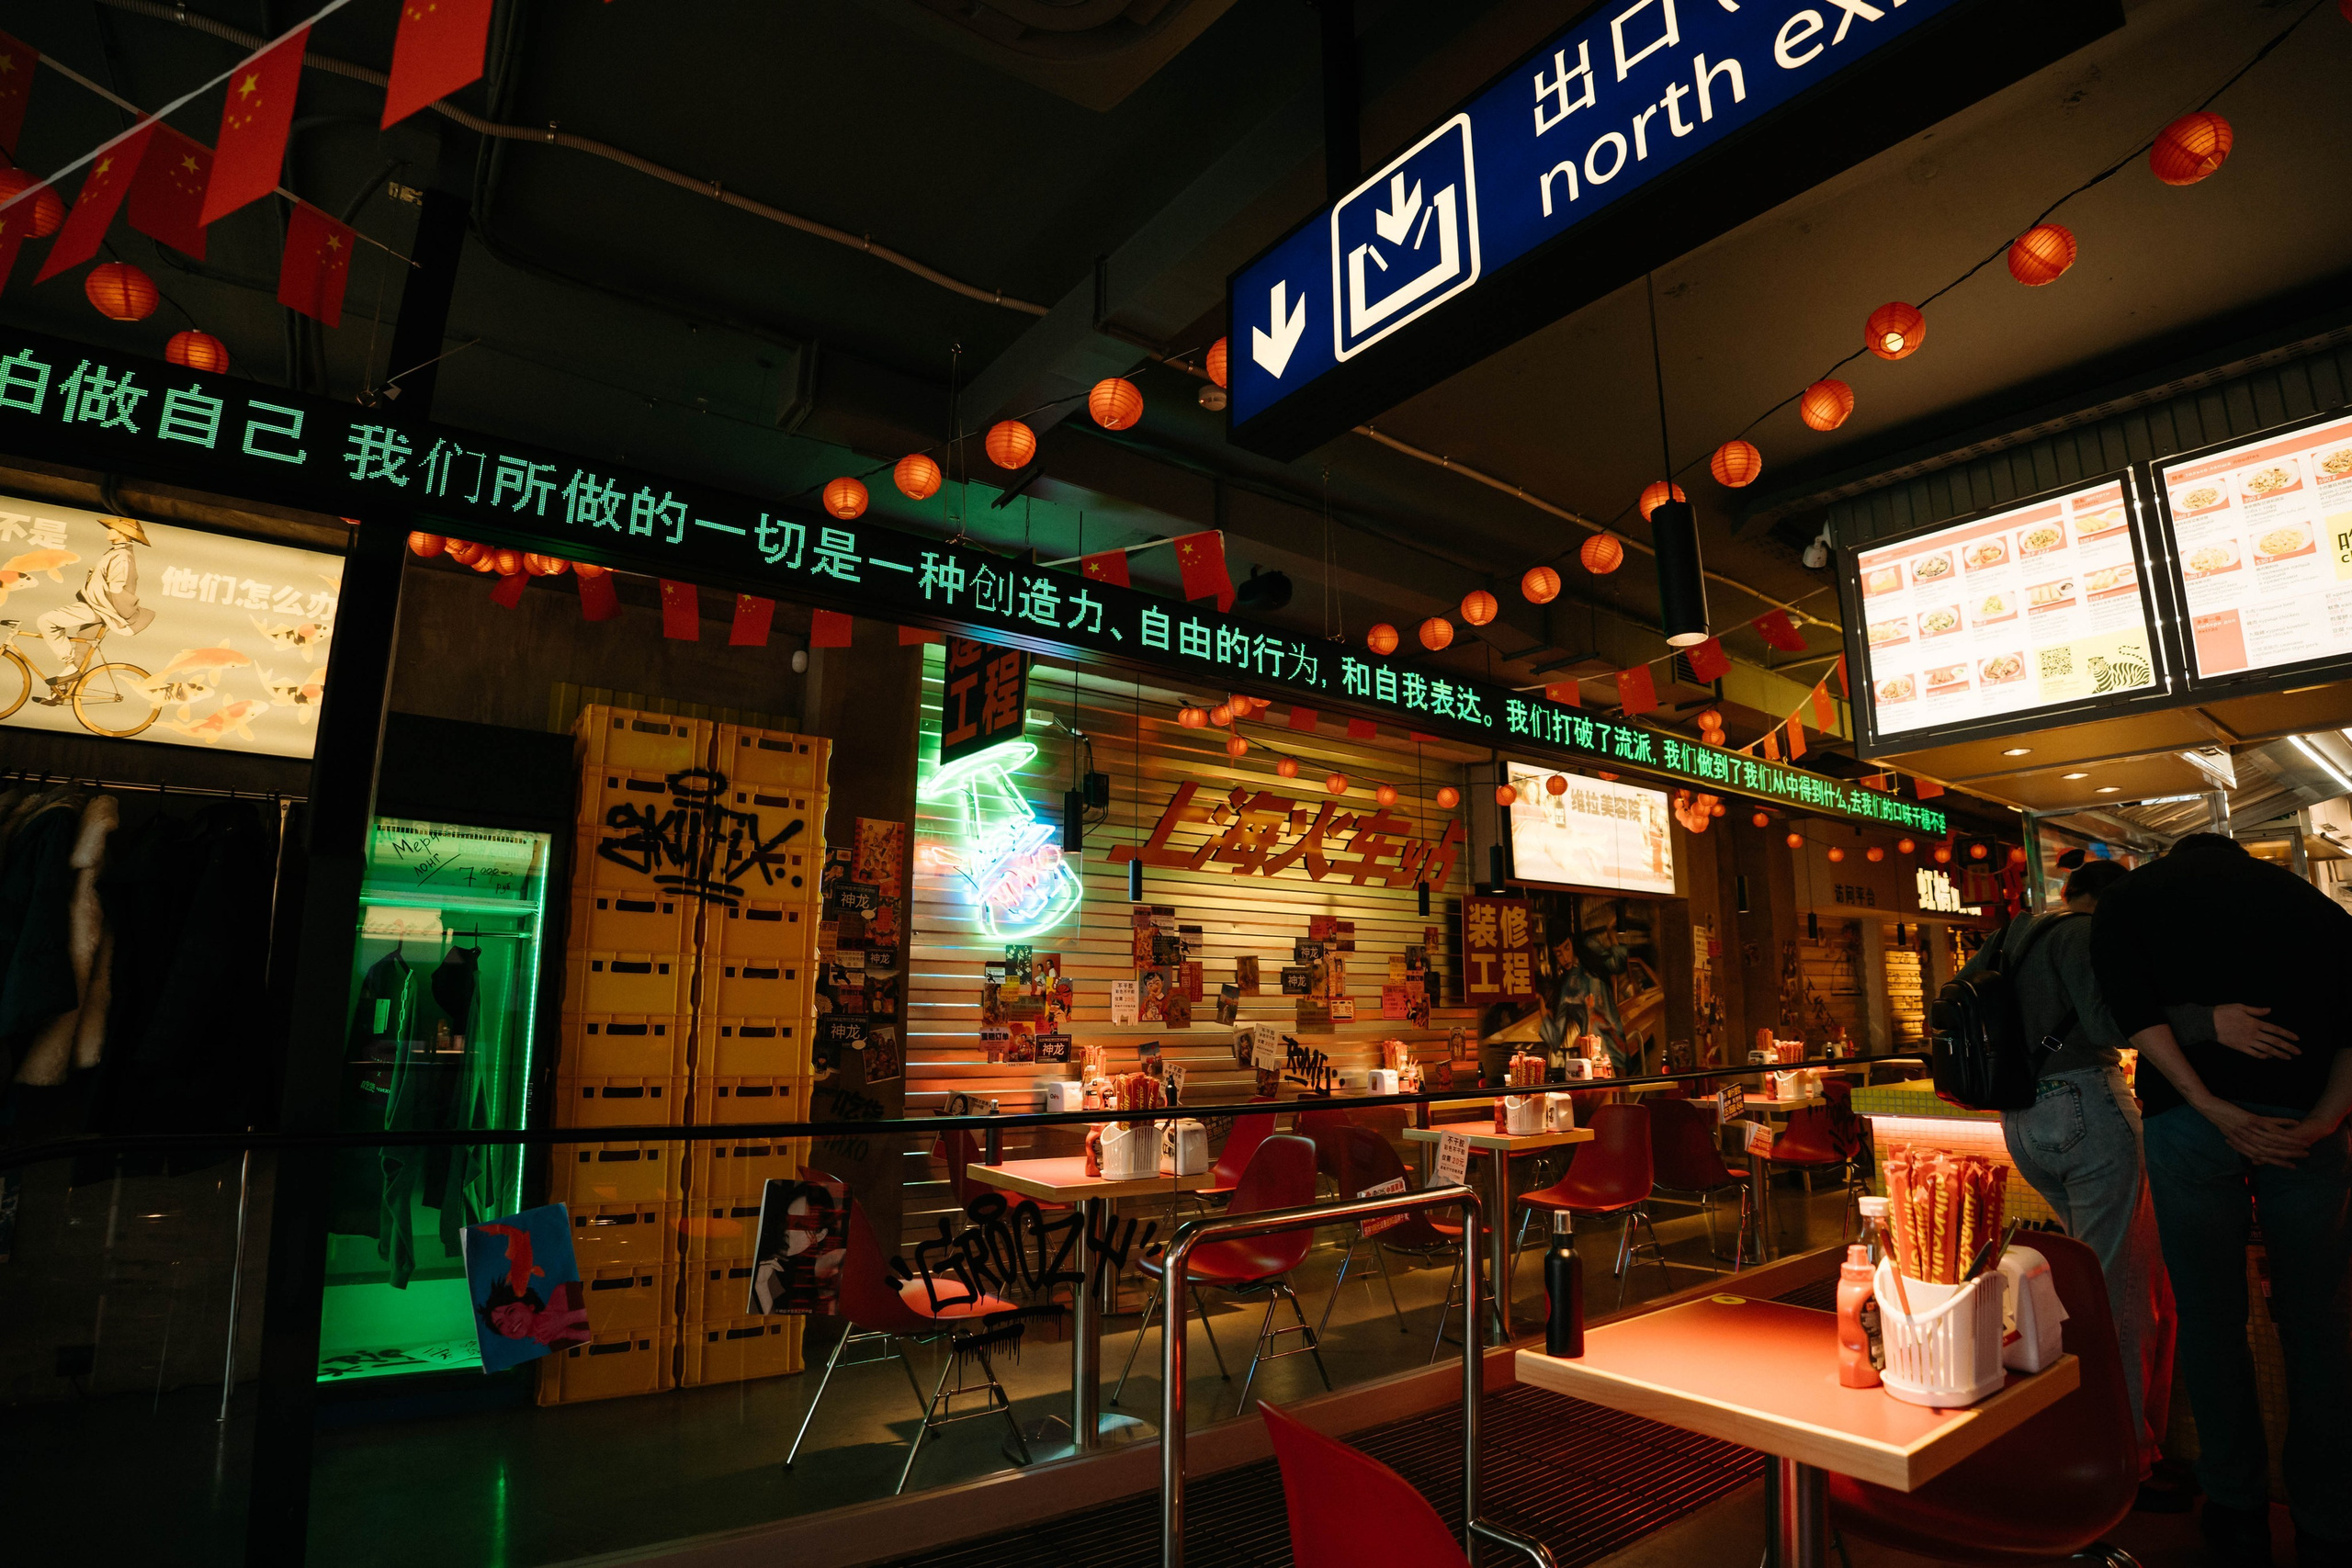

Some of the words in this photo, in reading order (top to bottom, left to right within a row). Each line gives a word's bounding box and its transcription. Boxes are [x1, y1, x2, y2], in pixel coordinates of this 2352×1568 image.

[1532, 0, 1740, 137] 出口
[1541, 52, 1747, 218] north
[1774, 0, 1908, 70] ex
[945, 649, 1021, 748] 工程
[1571, 788, 1641, 822] 维拉美容院
[392, 833, 440, 861] Мерч
[1108, 781, 1464, 891] 上海火车站
[413, 853, 441, 877] лонг
[840, 892, 870, 909] 神龙
[1468, 903, 1529, 949] 装修
[869, 953, 890, 964] 神龙
[1301, 946, 1318, 959] 神龙
[1288, 975, 1306, 987] 神龙
[1470, 952, 1532, 996] 工程
[831, 1024, 861, 1040] 神龙
[1043, 1043, 1065, 1056] 神龙
[1447, 1135, 1465, 1147] 不干胶
